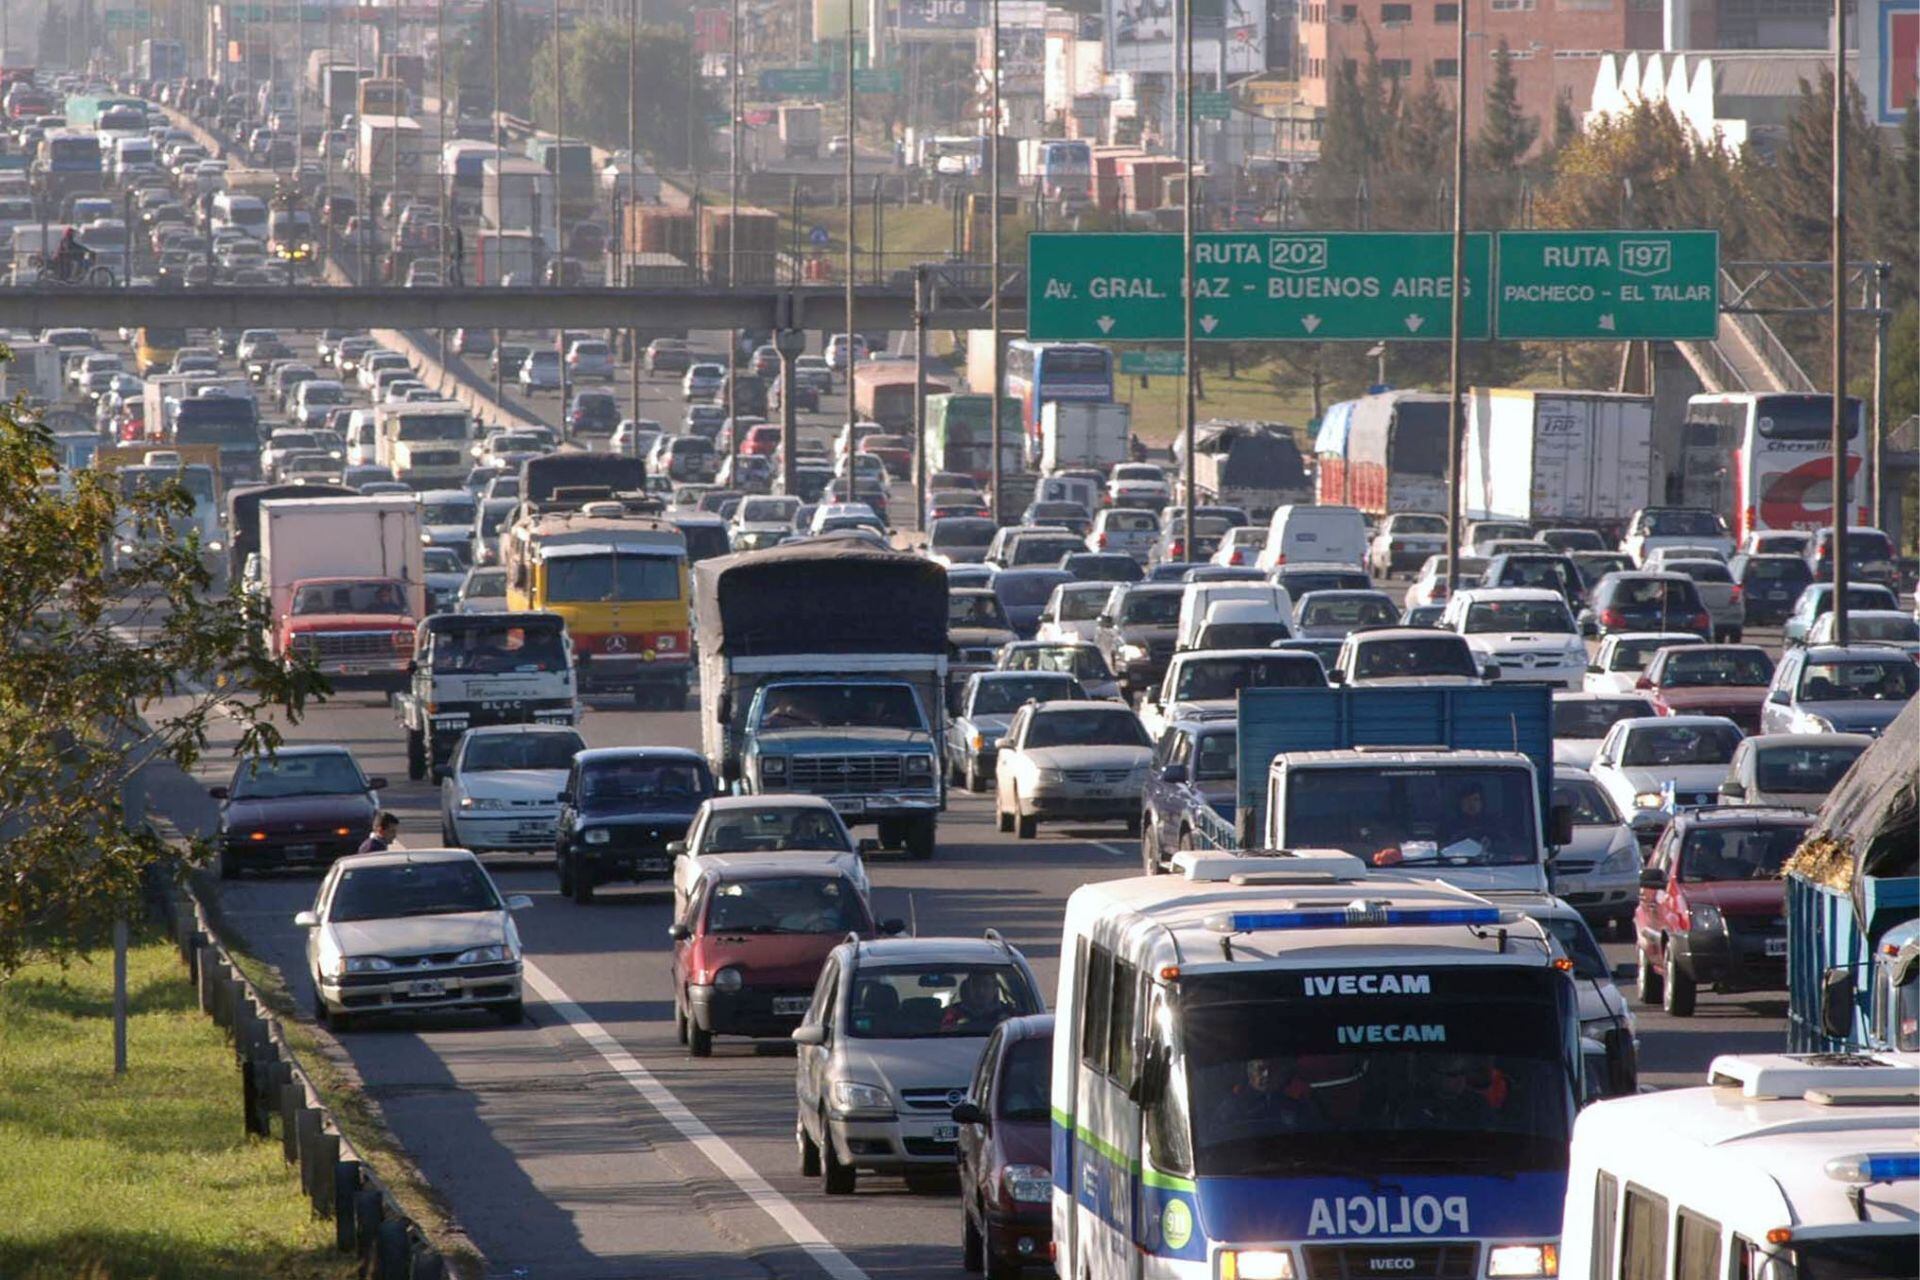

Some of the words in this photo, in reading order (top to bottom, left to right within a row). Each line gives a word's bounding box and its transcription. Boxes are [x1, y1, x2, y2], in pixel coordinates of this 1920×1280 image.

[1195, 243, 1262, 264] RUTA
[1273, 243, 1323, 264] 202
[1543, 246, 1611, 268] RUTA
[1625, 246, 1667, 268] 197
[1043, 277, 1077, 299] Av.
[1089, 277, 1167, 298] GRAL.
[1268, 276, 1380, 298] BUENOS
[1504, 284, 1595, 302] PACHECO
[1620, 285, 1645, 301] EL
[1651, 285, 1712, 301] TALAR
[1303, 974, 1431, 997] IVECAM
[1337, 1023, 1446, 1044] IVECAM
[1370, 1257, 1415, 1271] IVECO
